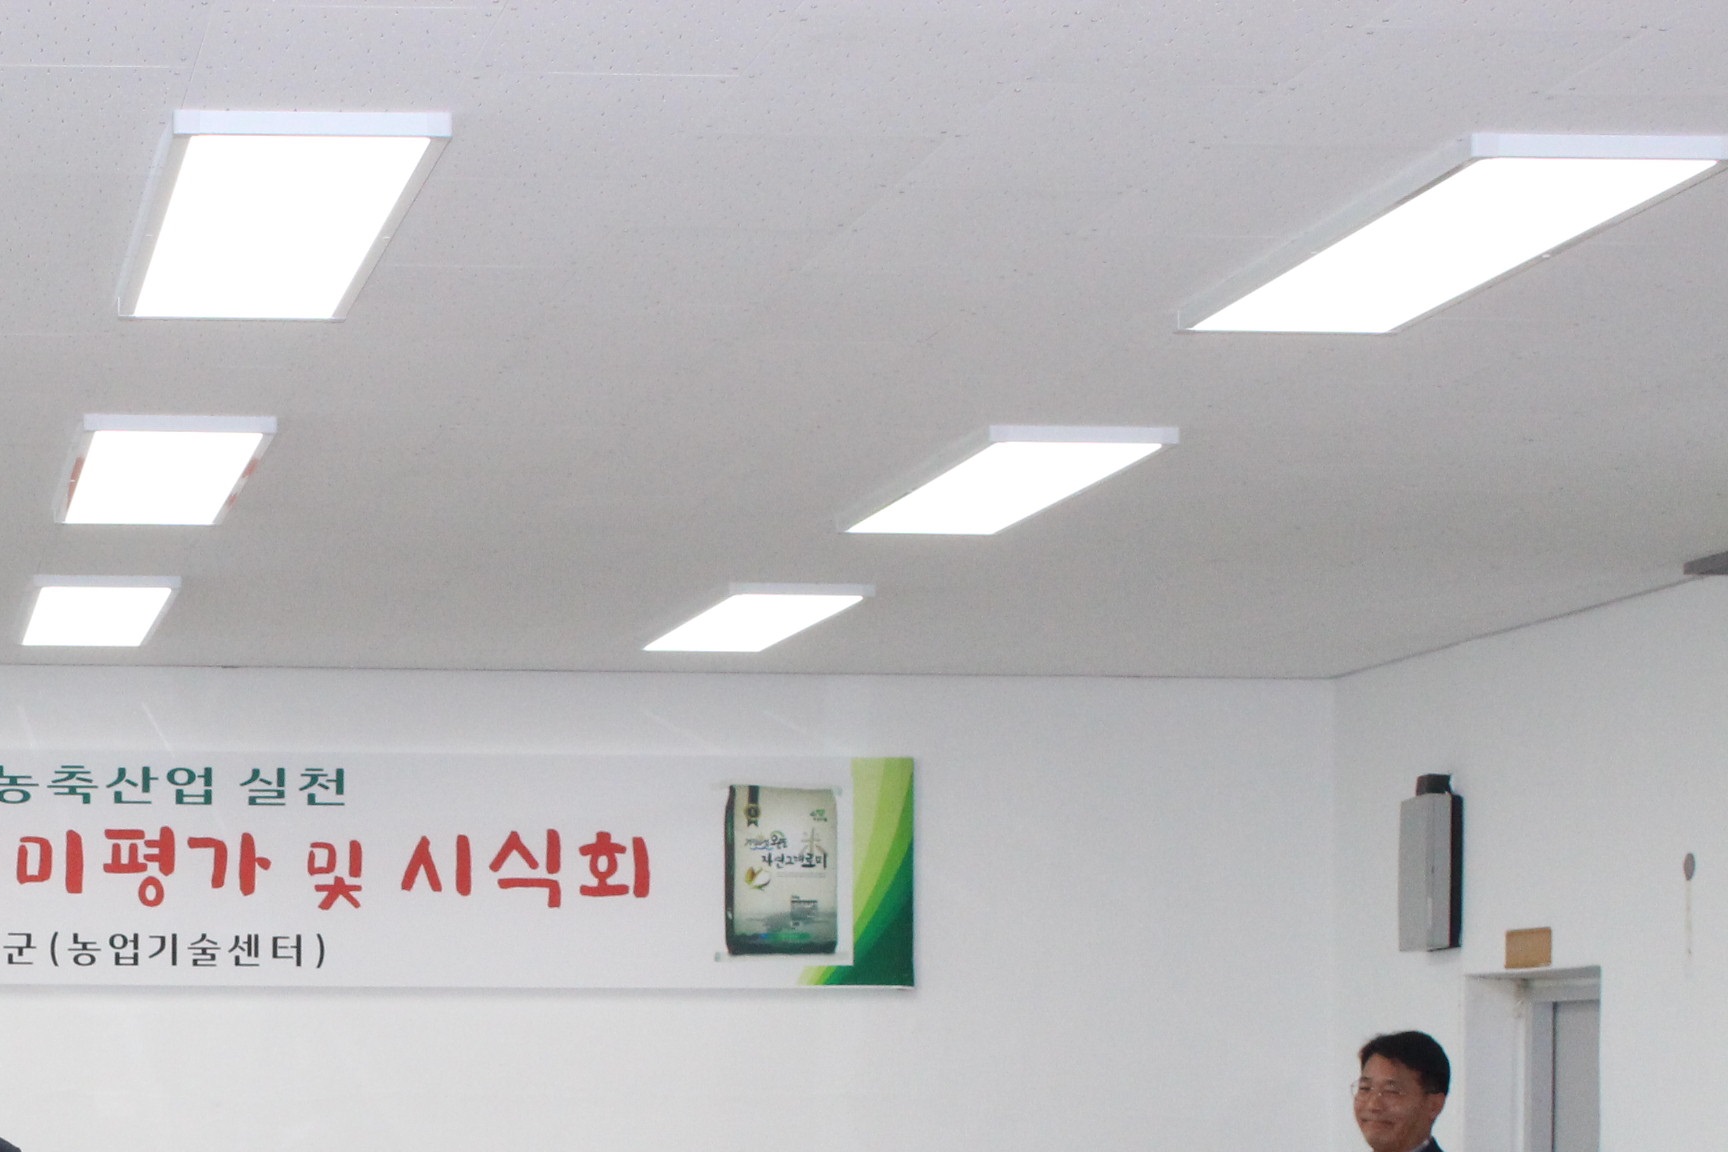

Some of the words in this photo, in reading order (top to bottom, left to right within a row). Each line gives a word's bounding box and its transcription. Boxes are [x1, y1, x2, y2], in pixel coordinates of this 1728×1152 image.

[239, 766, 347, 807] 실천
[306, 838, 364, 911] 및
[400, 828, 652, 909] 시식회
